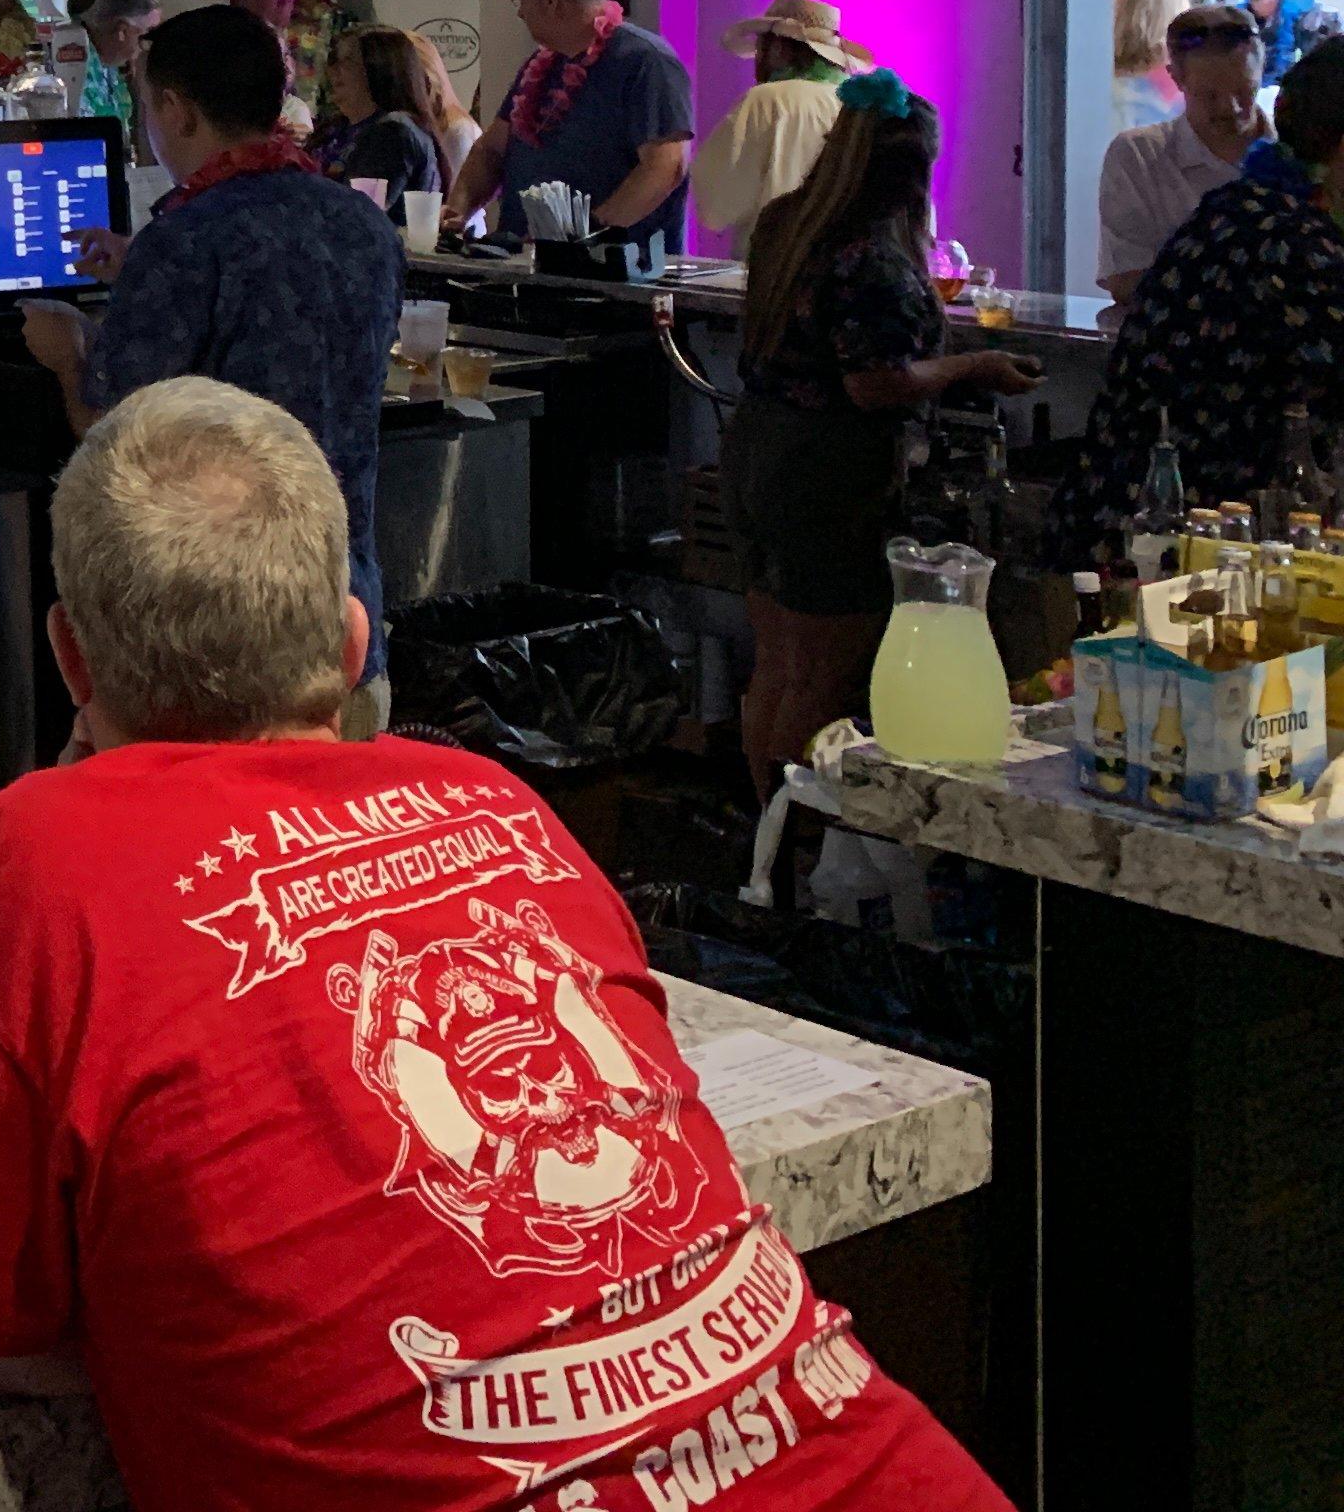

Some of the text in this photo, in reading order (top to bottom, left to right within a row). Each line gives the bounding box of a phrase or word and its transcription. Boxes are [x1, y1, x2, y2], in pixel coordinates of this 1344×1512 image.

[1241, 709, 1308, 750] Corona
[268, 780, 451, 856] ALL MEN
[277, 822, 512, 928] ARE CREATED EQUAL
[598, 1263, 663, 1325] BUT
[450, 1365, 558, 1433] THE
[563, 1325, 711, 1422] FINEST
[632, 1364, 800, 1512] COAST
